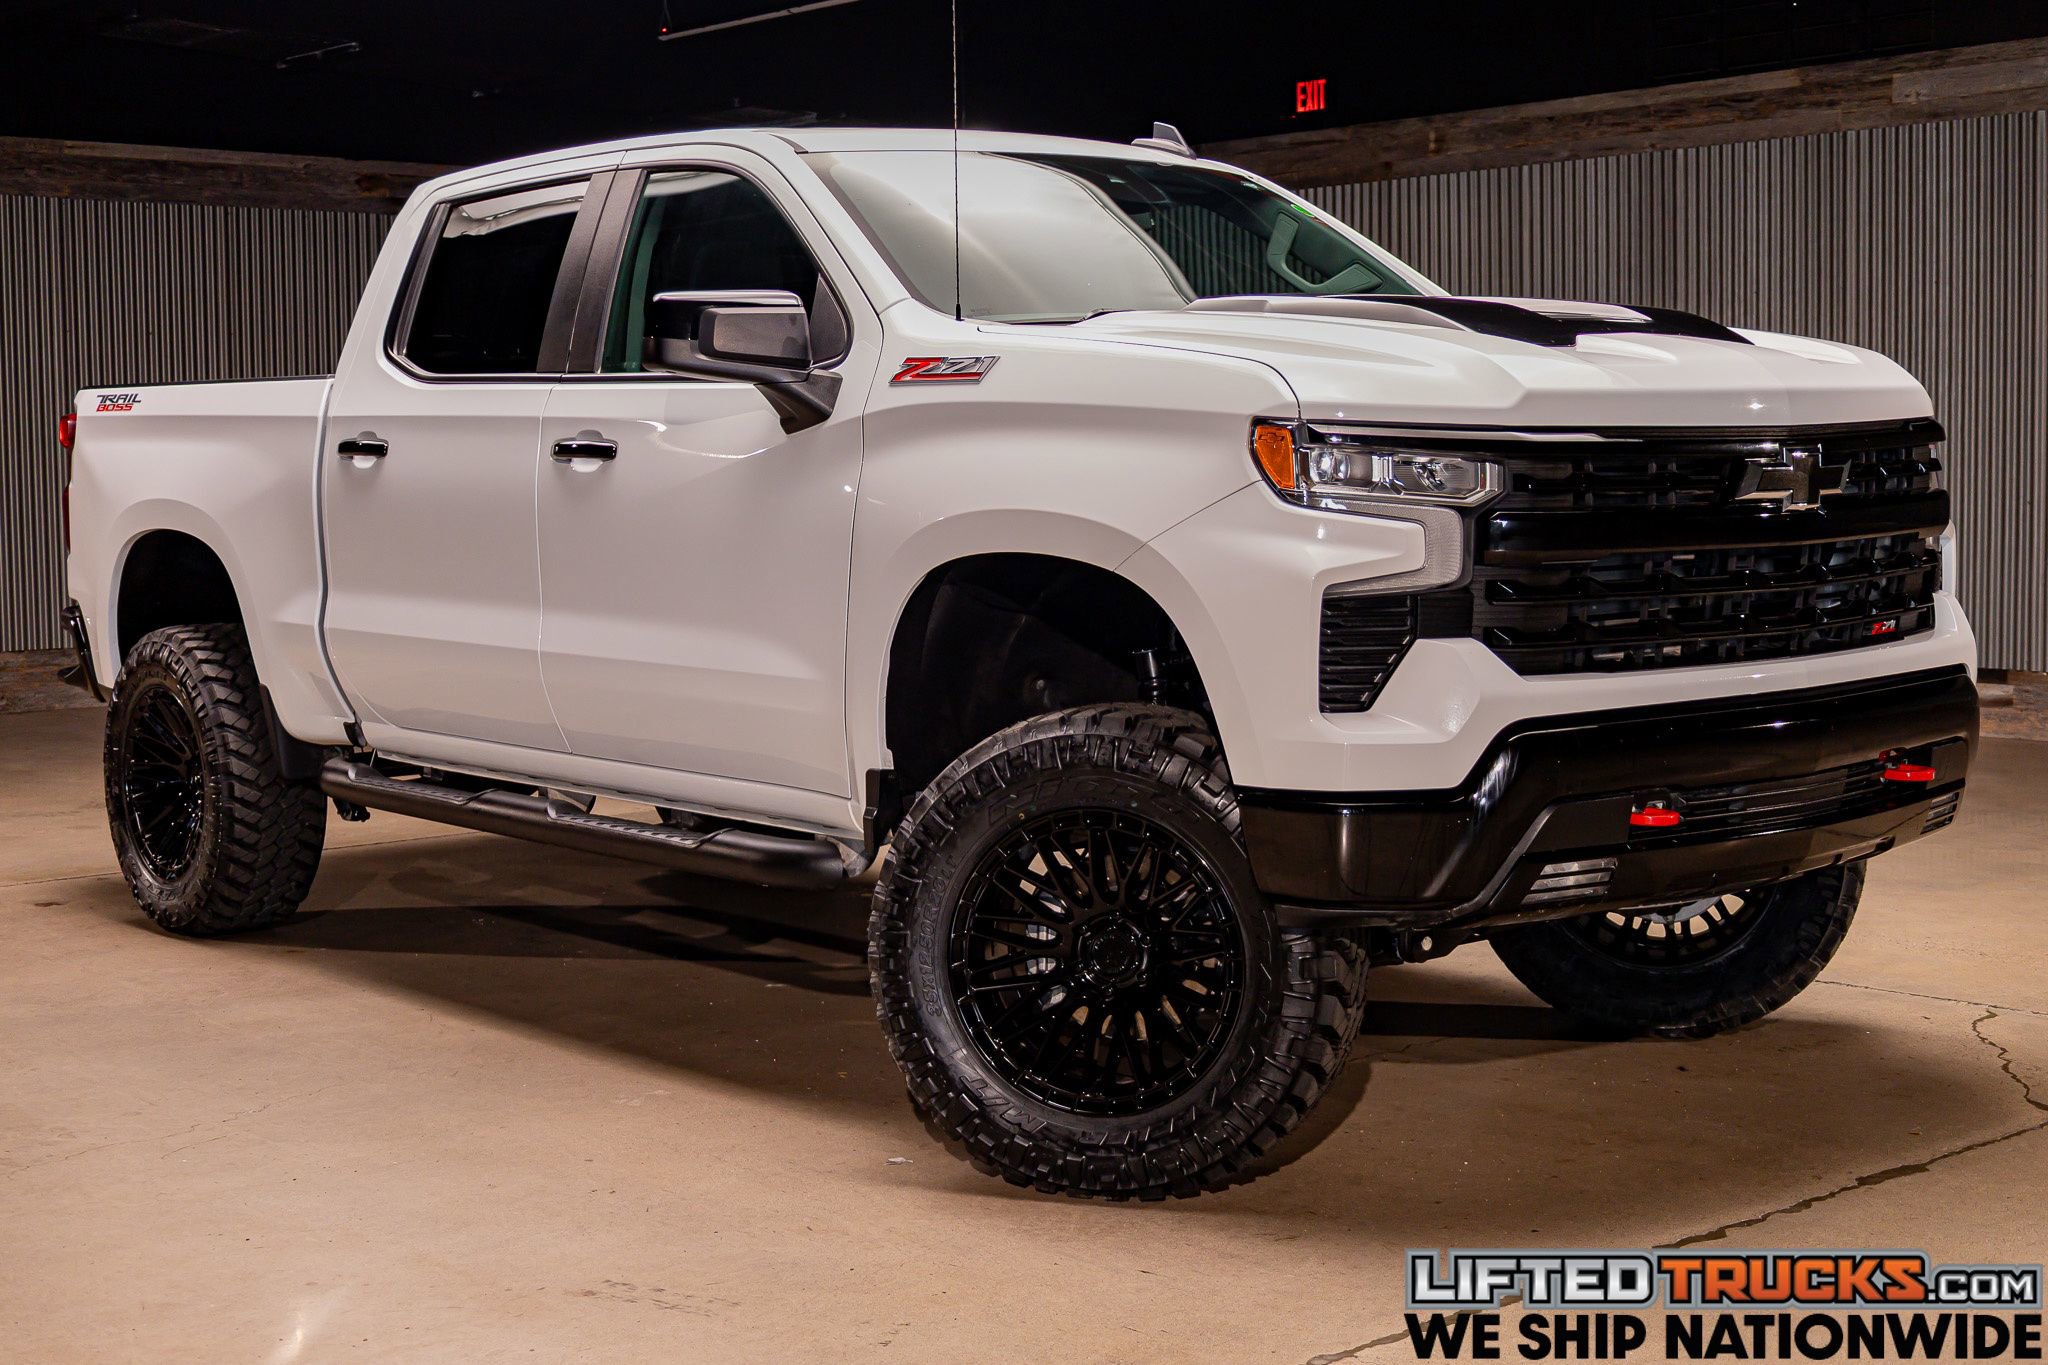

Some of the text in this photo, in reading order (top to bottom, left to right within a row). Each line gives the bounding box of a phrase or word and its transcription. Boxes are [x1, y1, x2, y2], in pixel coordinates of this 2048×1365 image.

[1296, 79, 1327, 112] EXIT
[889, 356, 1000, 384] Z71
[96, 403, 134, 412] BOSS
[97, 393, 141, 403] TRAIL
